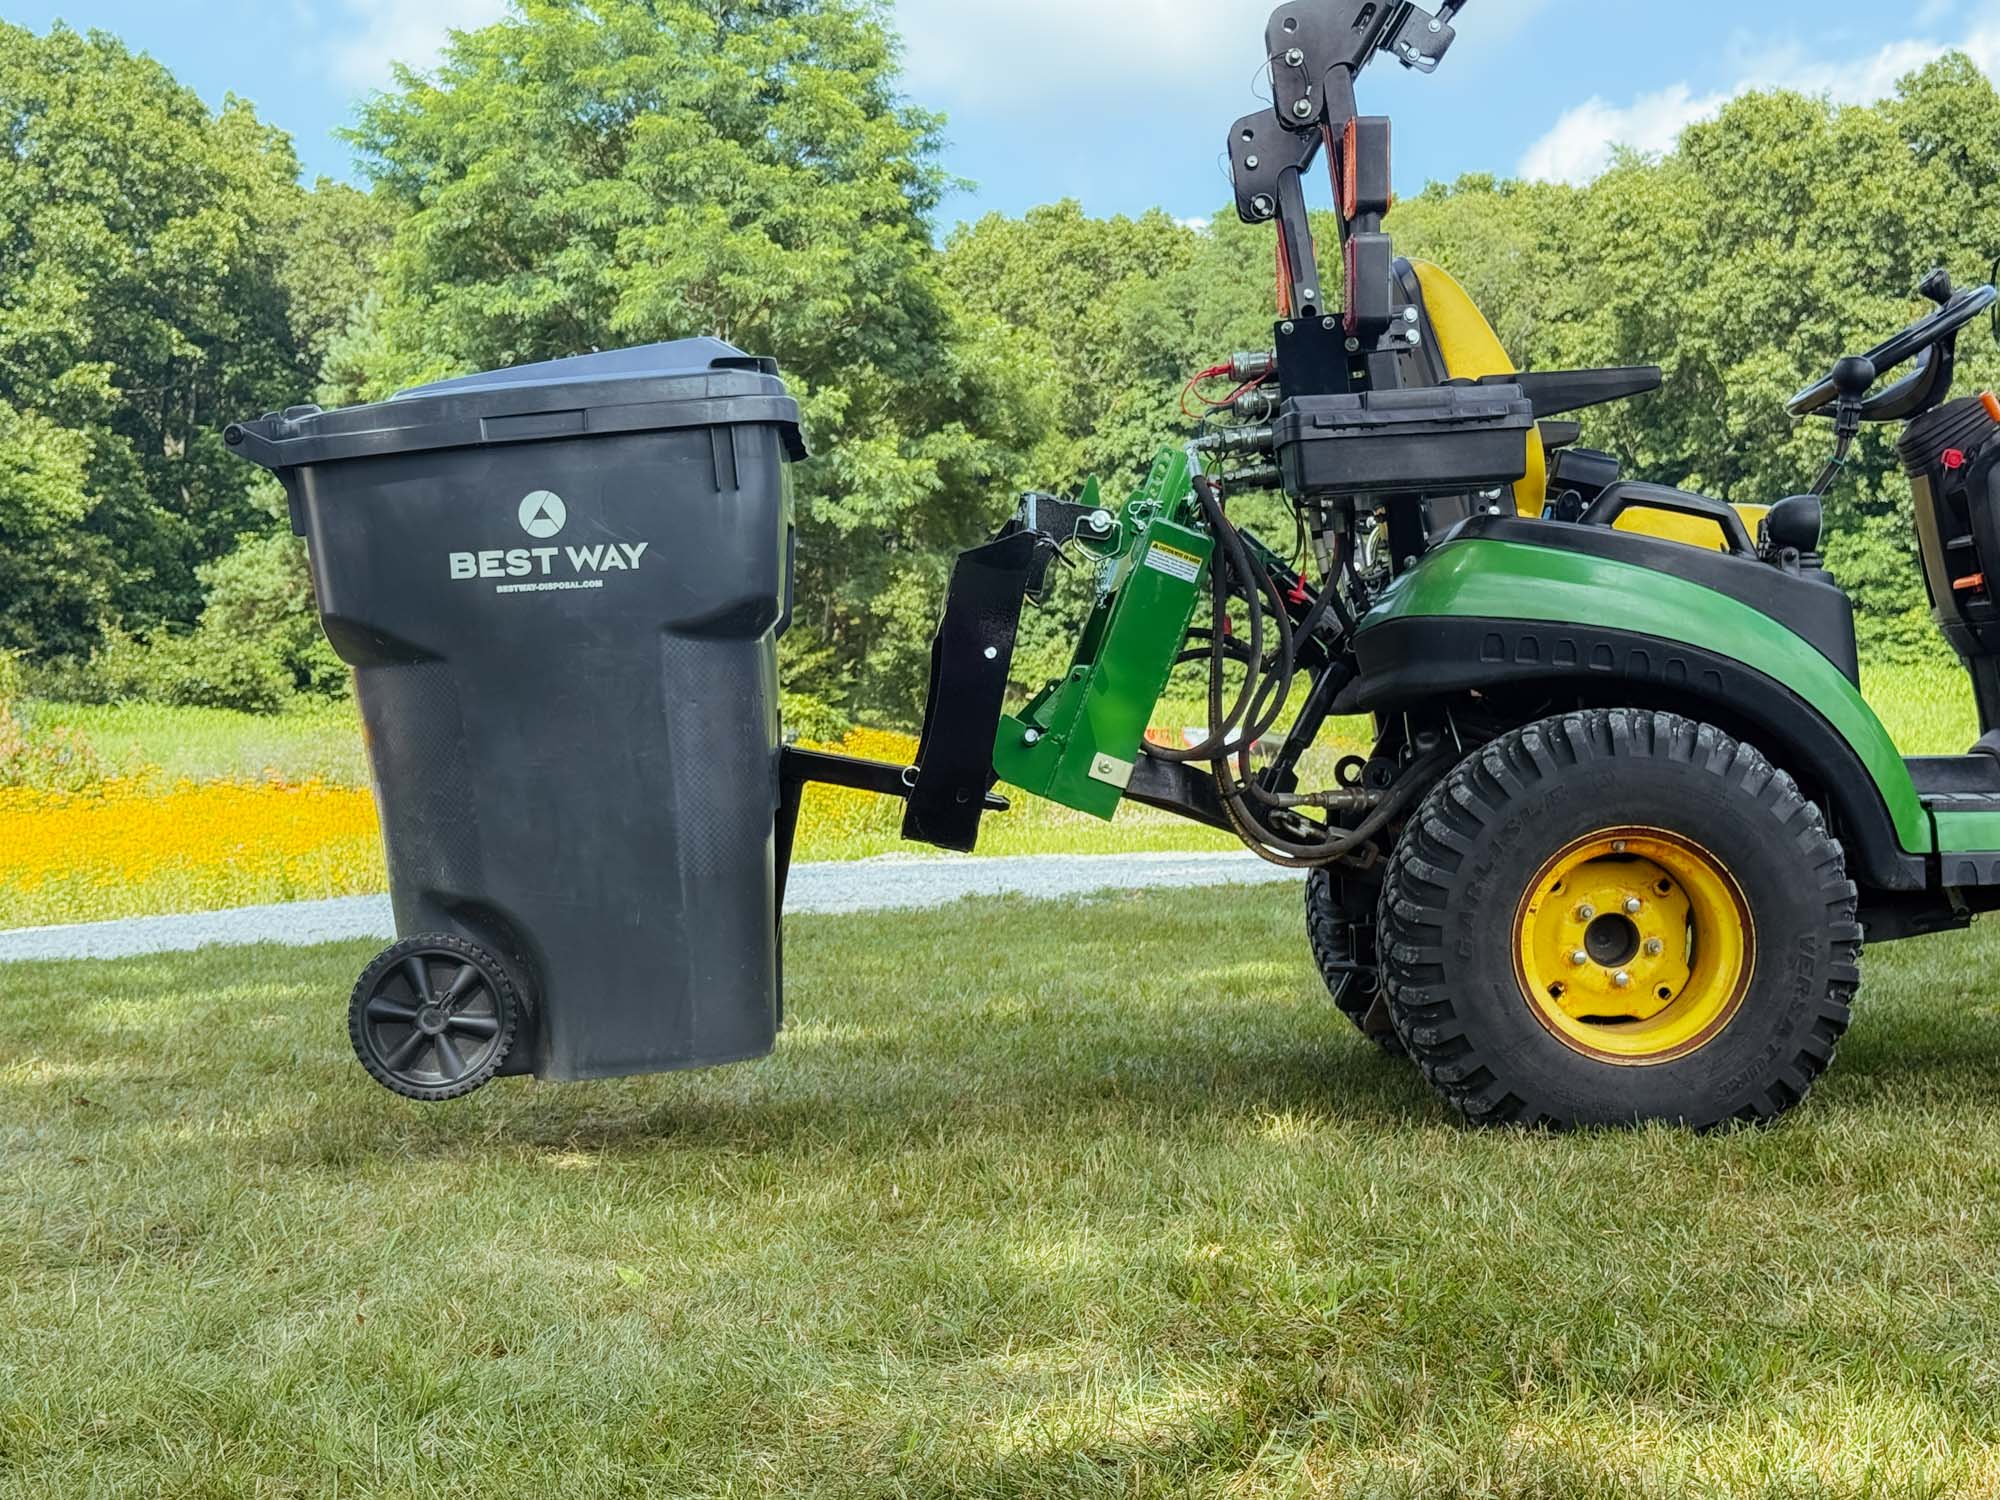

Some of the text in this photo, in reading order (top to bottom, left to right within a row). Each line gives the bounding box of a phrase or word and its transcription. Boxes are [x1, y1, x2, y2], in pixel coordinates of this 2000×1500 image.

[450, 542, 649, 579] BEST WAY
[496, 579, 603, 593] BESTWAY-DISPOSAL.COM
